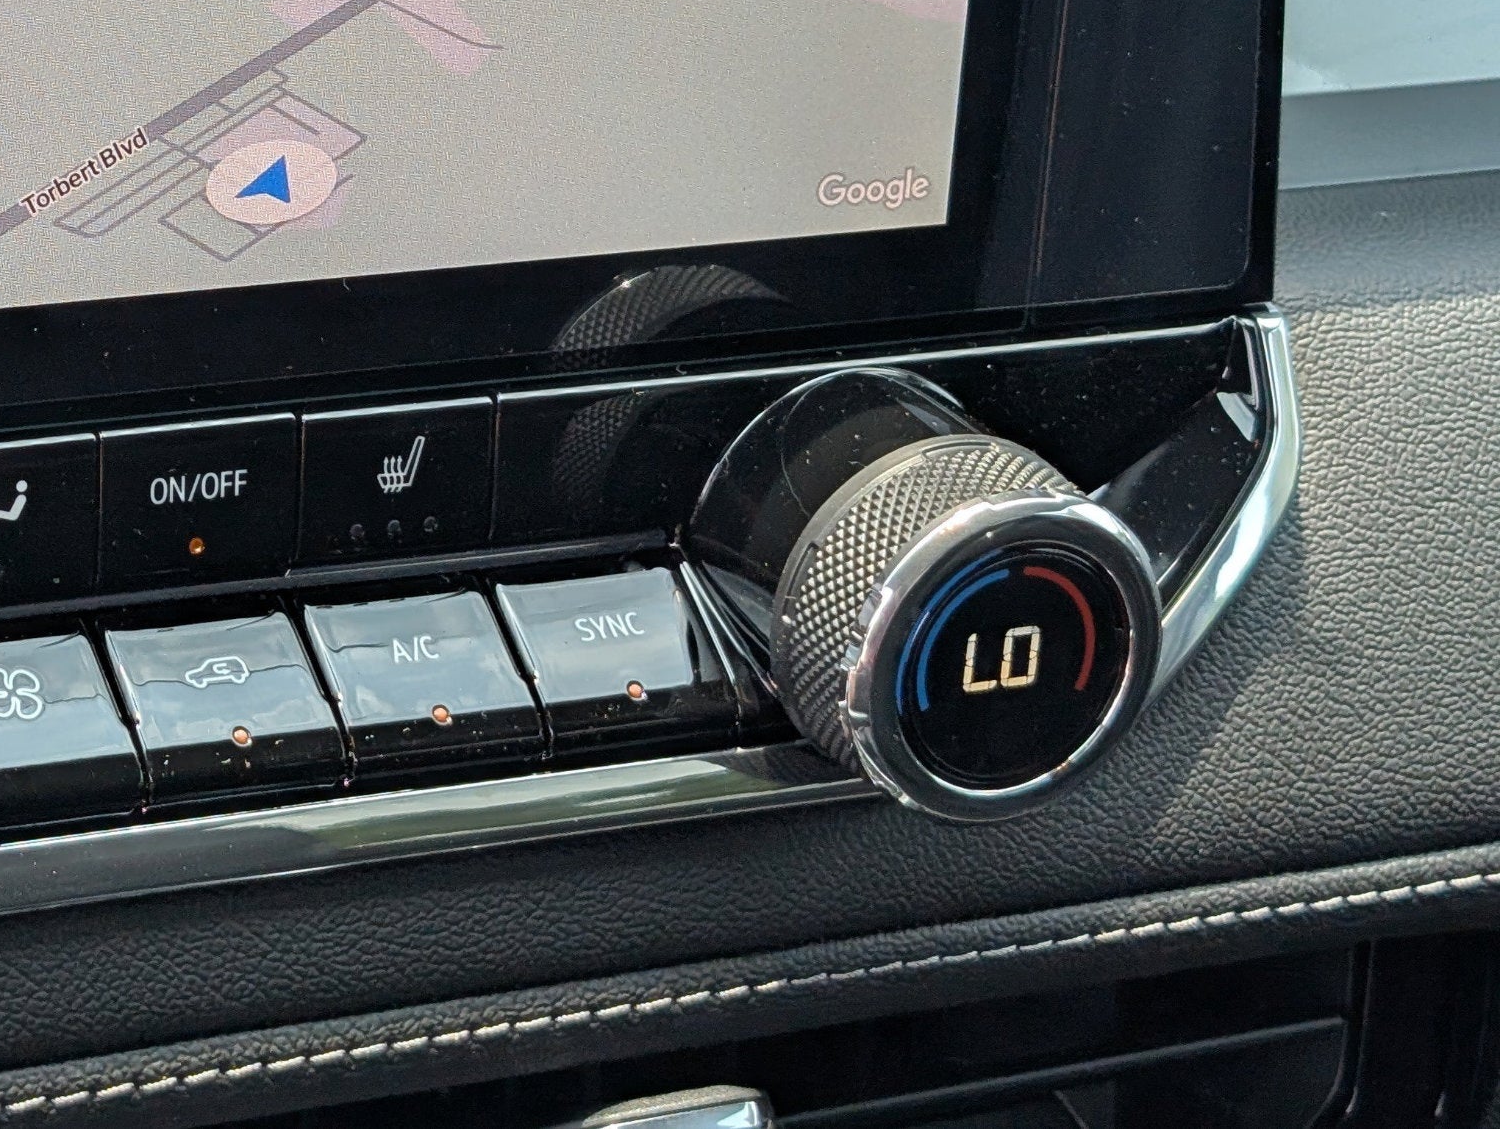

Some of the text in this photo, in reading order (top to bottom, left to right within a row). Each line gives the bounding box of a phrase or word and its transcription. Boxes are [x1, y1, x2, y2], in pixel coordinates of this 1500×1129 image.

[20, 126, 148, 214] Torbert Blvd
[817, 167, 930, 210] Google
[149, 469, 248, 506] ON/OFF
[573, 611, 646, 643] SYNC
[391, 634, 440, 664] A/C
